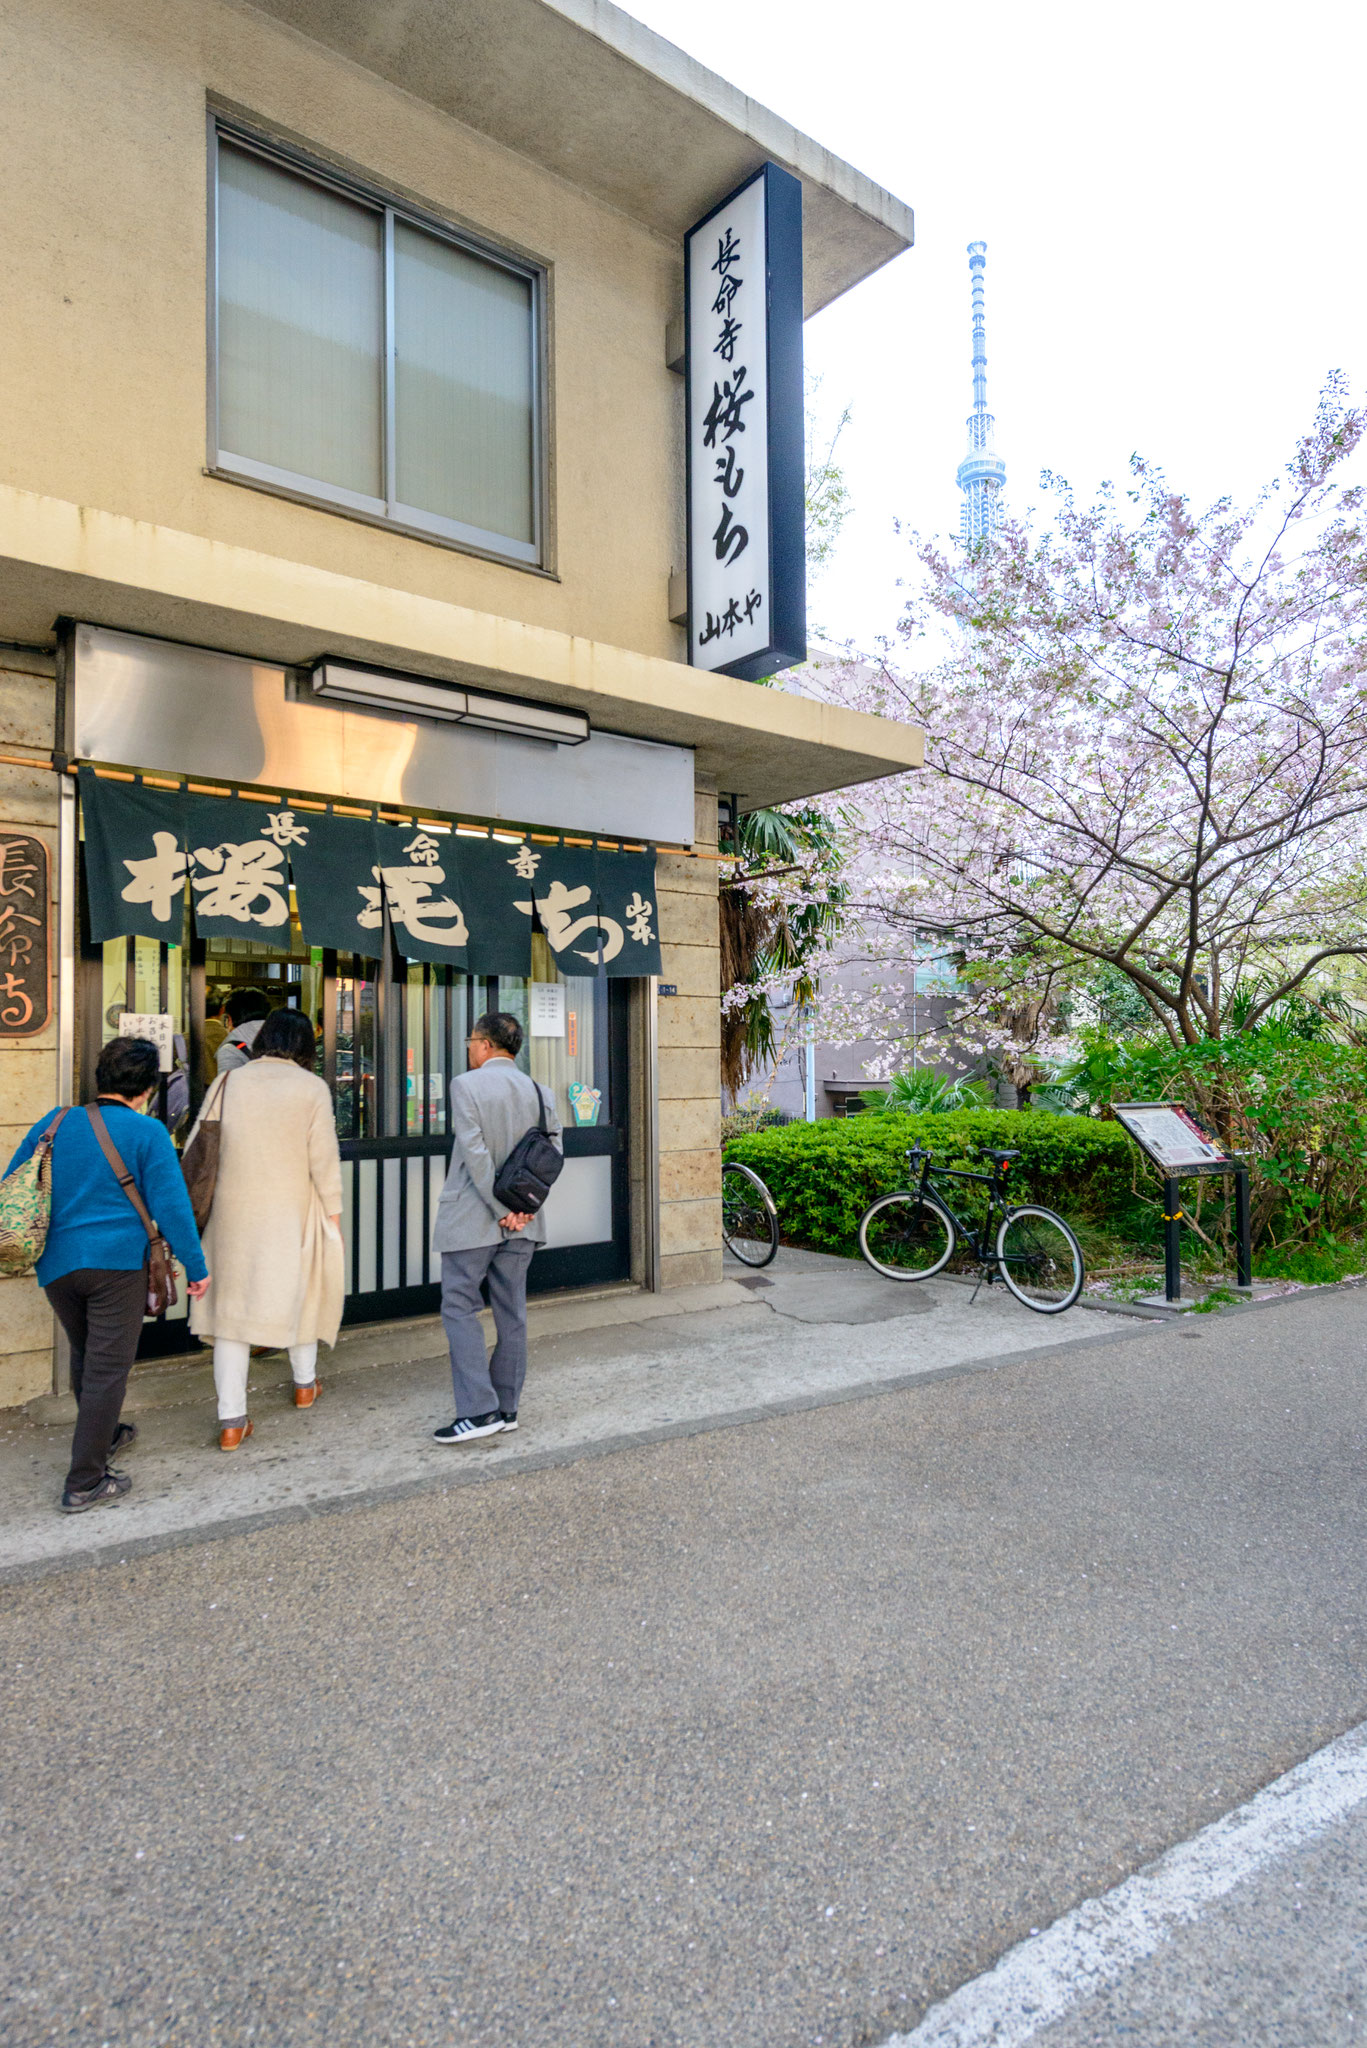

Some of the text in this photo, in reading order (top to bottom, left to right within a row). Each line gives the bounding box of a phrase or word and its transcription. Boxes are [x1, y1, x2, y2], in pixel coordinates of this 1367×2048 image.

[699, 588, 762, 646] 山本や
[626, 892, 656, 946] 山本
